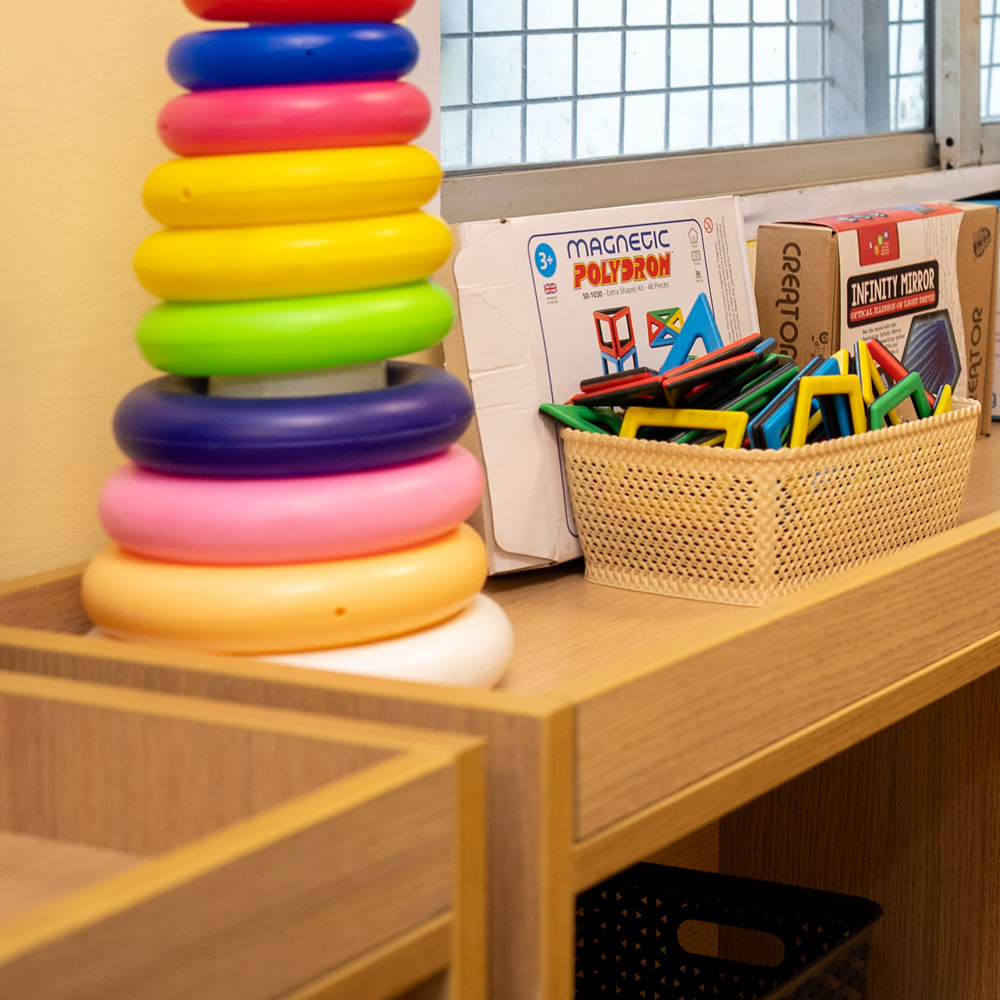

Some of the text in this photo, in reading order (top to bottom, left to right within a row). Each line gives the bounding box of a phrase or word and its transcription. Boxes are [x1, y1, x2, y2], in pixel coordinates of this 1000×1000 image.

[566, 229, 671, 260] MAGNETIC
[538, 251, 554, 270] 3+
[573, 251, 672, 290] POLYDRON
[606, 287, 619, 297] Extra
[619, 284, 638, 295] Shapes
[851, 267, 935, 307] INFINITY MIRROR
[850, 307, 873, 320] OPTICAL
